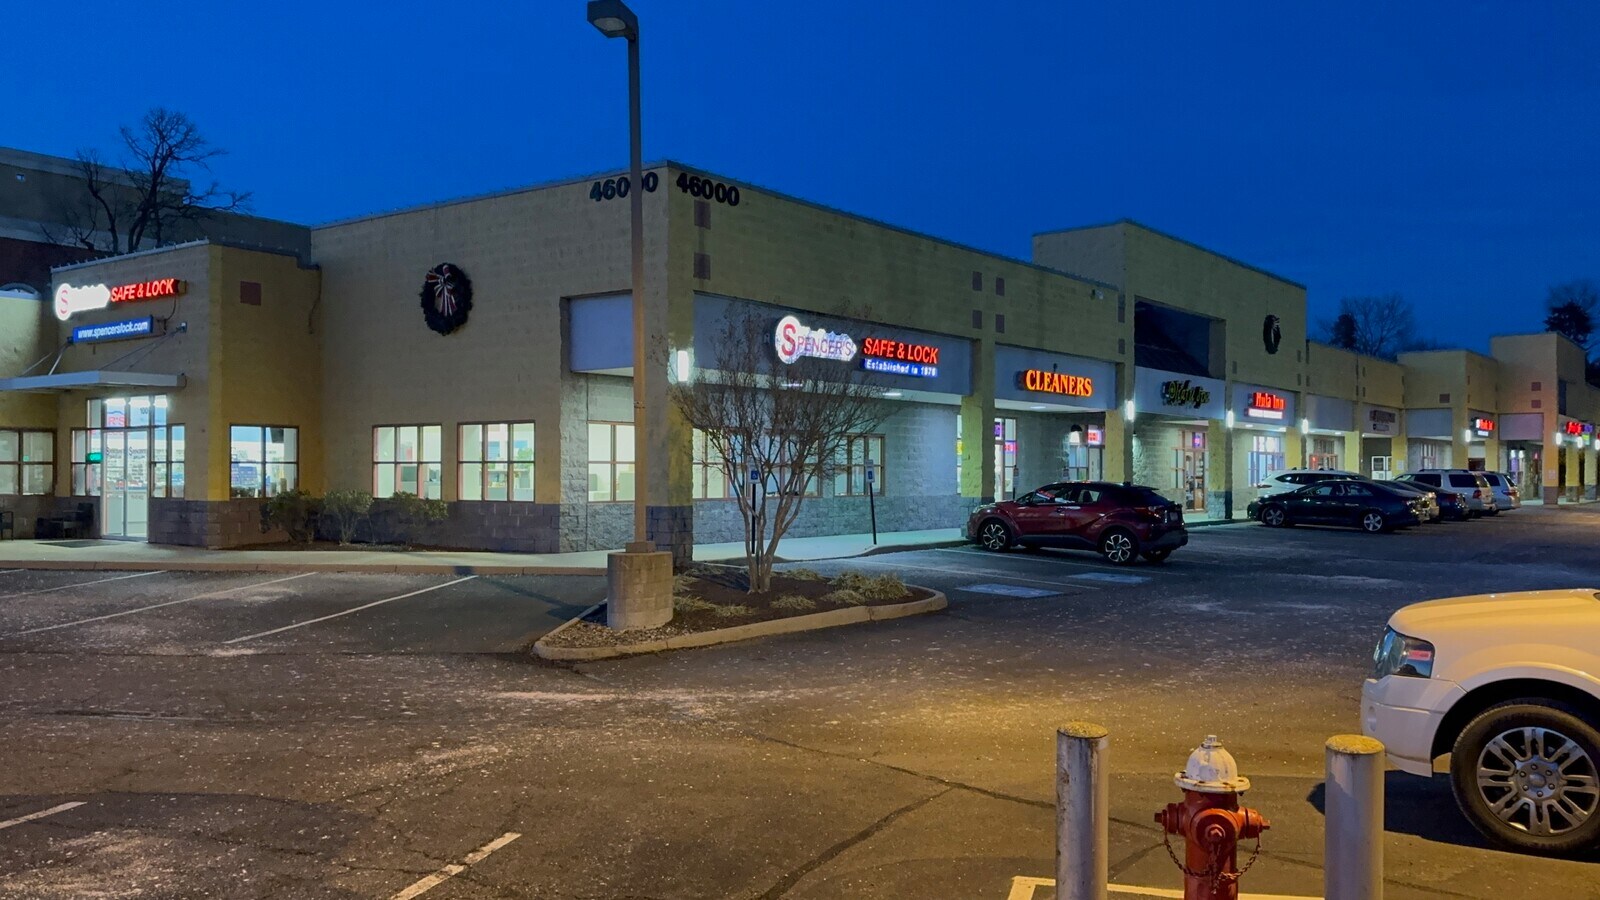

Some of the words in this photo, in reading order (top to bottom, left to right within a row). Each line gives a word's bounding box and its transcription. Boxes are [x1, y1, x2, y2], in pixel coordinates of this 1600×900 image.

[589, 171, 659, 202] 4600
[676, 172, 740, 206] 46000
[110, 284, 135, 302] SAFE
[137, 284, 143, 297] &
[145, 279, 174, 297] LOCK
[77, 322, 148, 338] www.spencerslock.com
[863, 337, 895, 358] SAFE
[897, 342, 905, 359] &
[907, 344, 939, 364] LOCK
[866, 359, 909, 374] Established
[1026, 370, 1092, 397] CLEANERS
